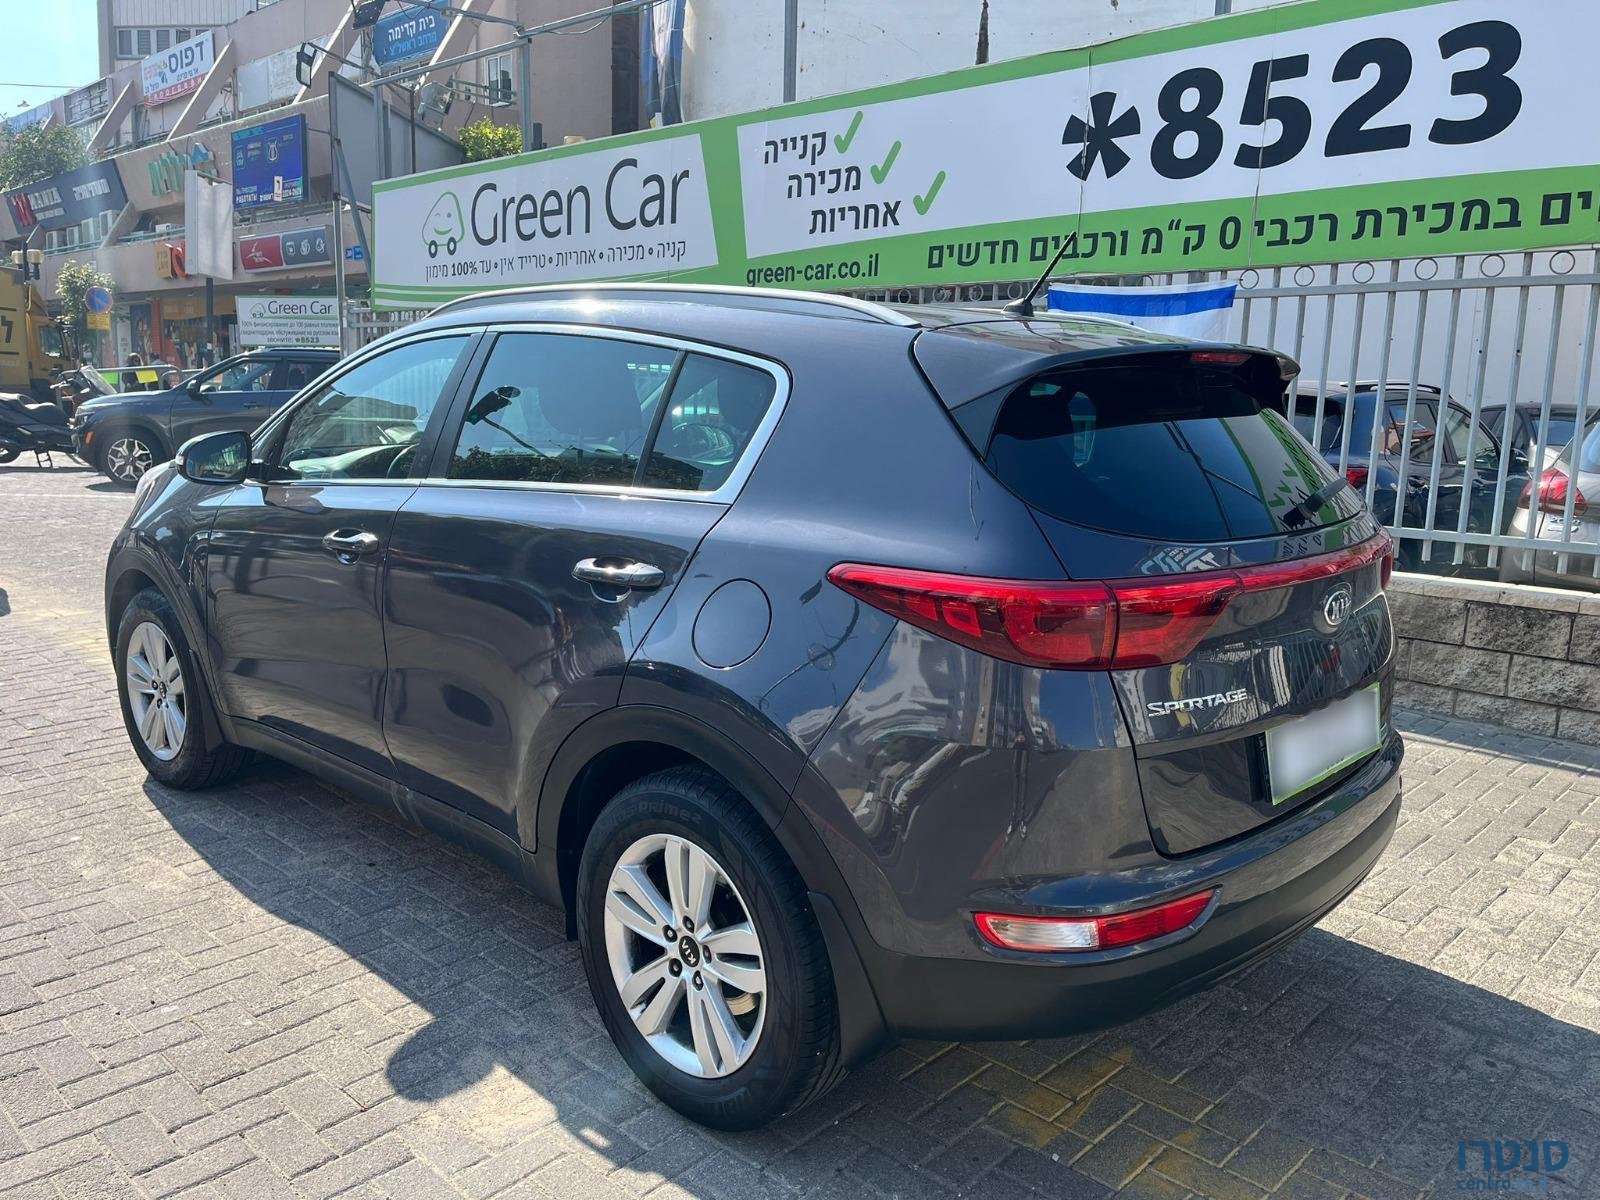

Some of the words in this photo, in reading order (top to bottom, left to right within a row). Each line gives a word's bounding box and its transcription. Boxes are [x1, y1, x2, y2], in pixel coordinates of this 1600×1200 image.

[388, 20, 416, 42] קדימה
[419, 15, 436, 31] בית
[168, 41, 204, 73] דפוס
[763, 131, 827, 165] קנייה
[787, 165, 861, 199] מכירה
[471, 182, 591, 246] Green
[605, 157, 690, 231] Car
[1540, 191, 1600, 226] ים
[809, 200, 901, 235] אחריות
[1219, 215, 1241, 250] 0
[1254, 211, 1339, 246] רכבי
[1352, 196, 1521, 241] במכירת
[555, 248, 596, 267] אחריות
[607, 243, 645, 264] מכירה
[656, 240, 686, 263] קניה
[928, 239, 1019, 269] חדשים
[1030, 229, 1128, 262] ורכבים
[425, 262, 449, 282] מימון
[451, 260, 477, 275] 100%
[479, 259, 491, 274] עד
[499, 256, 514, 278] אין
[518, 252, 546, 270] טרייד
[746, 253, 879, 287] green-car.co.il
[267, 300, 306, 314] Green
[310, 300, 332, 314] Car
[1147, 688, 1248, 718] SPORTAGE
[682, 939, 697, 964] KIA
